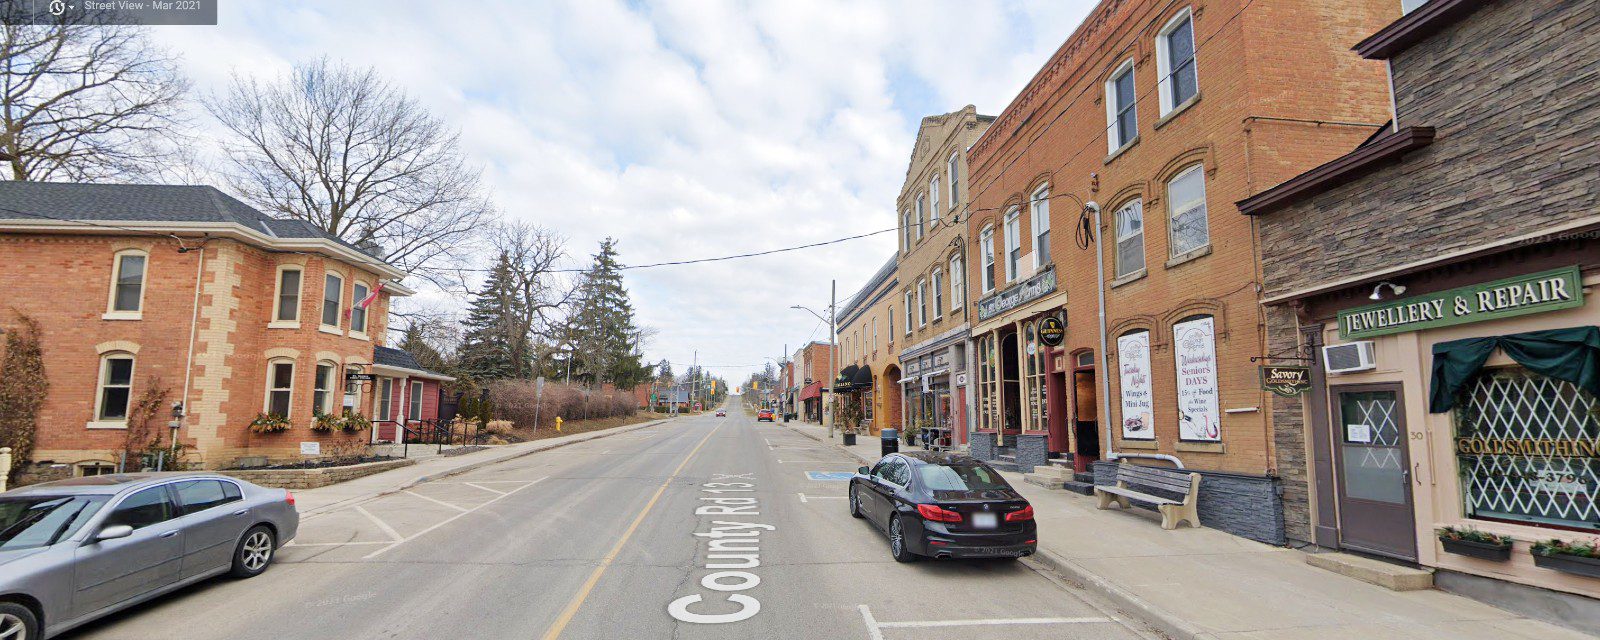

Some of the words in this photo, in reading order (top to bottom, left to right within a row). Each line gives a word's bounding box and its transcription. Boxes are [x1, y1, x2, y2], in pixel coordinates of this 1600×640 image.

[1345, 299, 1445, 337] JEWELLERY
[1453, 295, 1472, 316] &
[1476, 277, 1571, 312] REPAIR
[1181, 367, 1211, 375] Seniors
[1185, 376, 1208, 385] DAYS
[1271, 368, 1304, 385] Savory
[1410, 431, 1423, 440] 30
